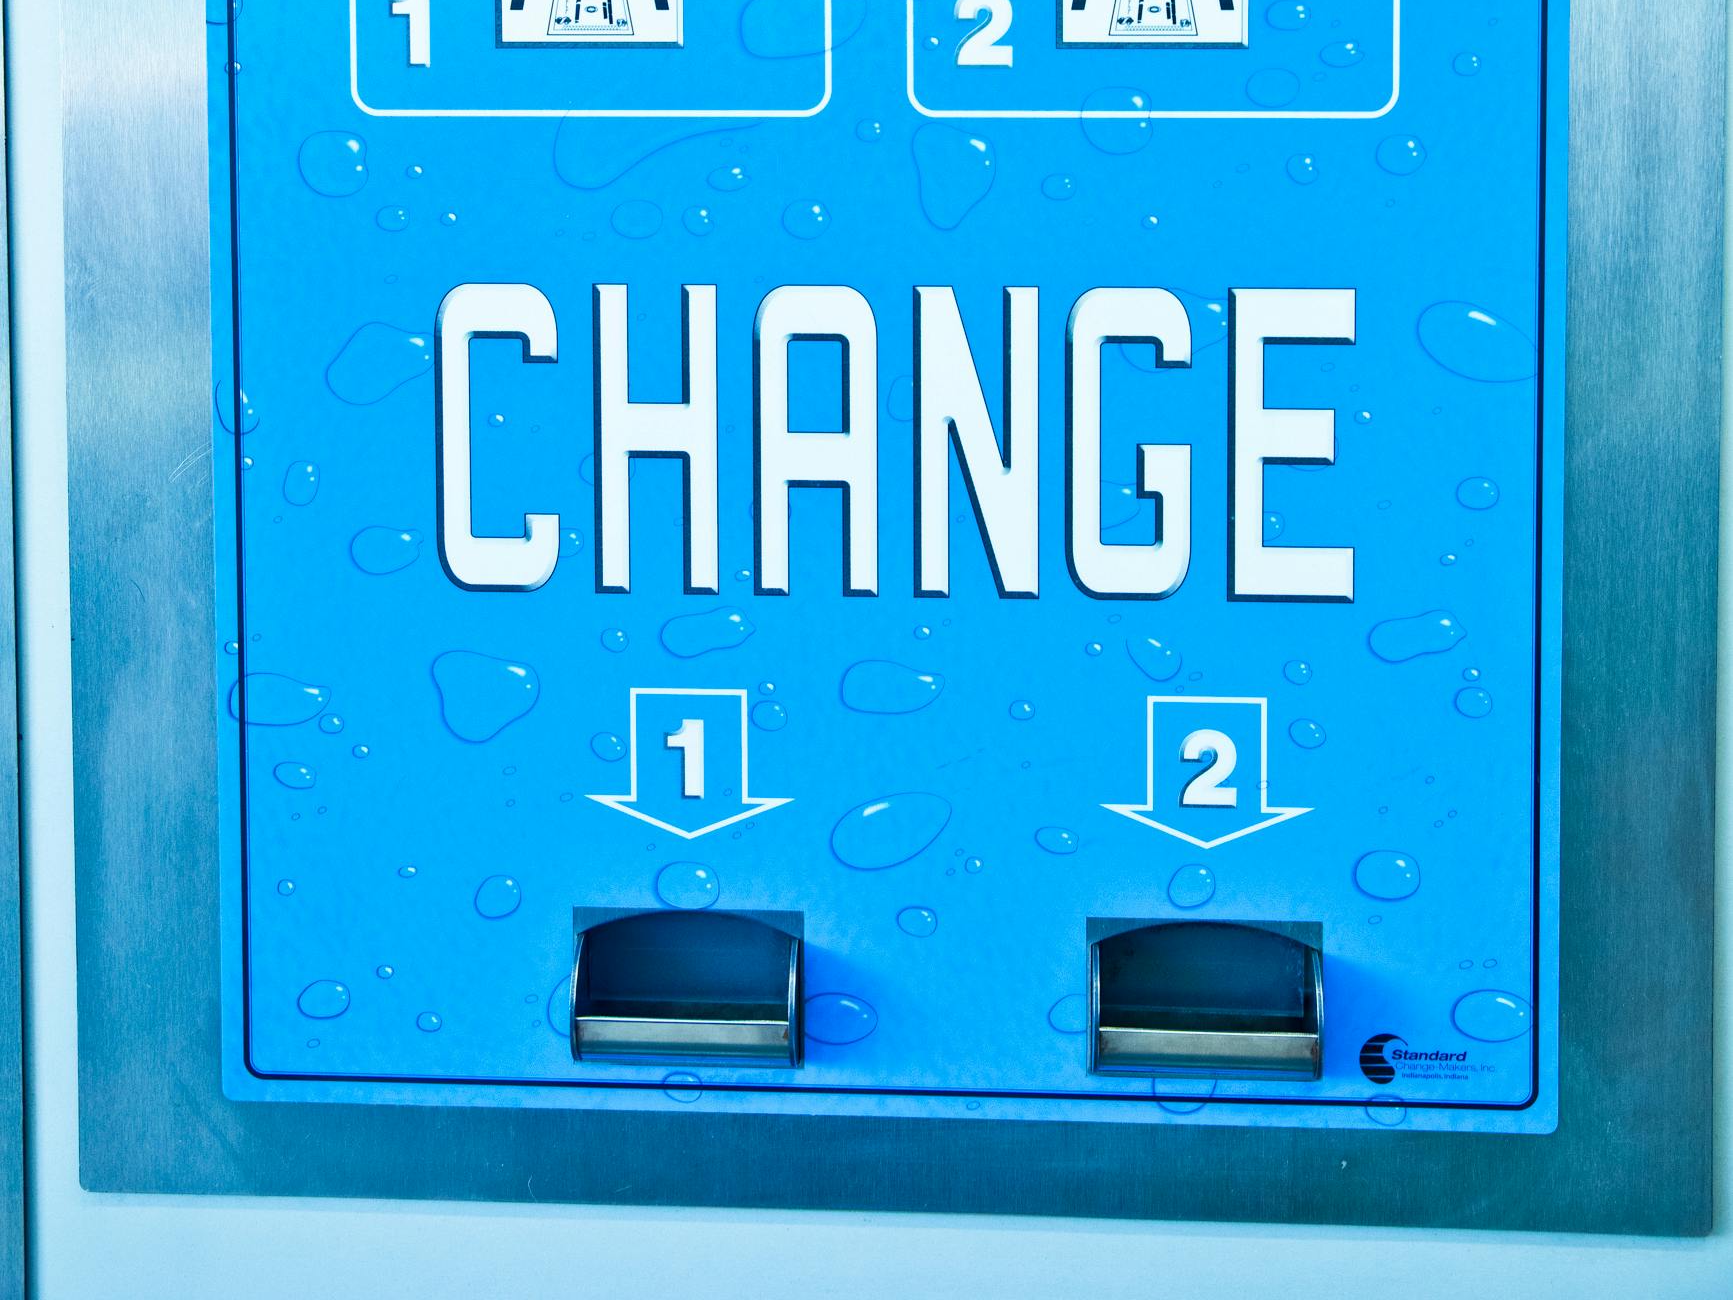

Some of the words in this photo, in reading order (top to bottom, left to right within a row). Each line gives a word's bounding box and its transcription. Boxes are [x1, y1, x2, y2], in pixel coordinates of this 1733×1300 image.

[434, 281, 1357, 603] CHANGE
[666, 718, 705, 799] 1
[1179, 728, 1238, 809] 2
[1391, 1049, 1467, 1061] Standard
